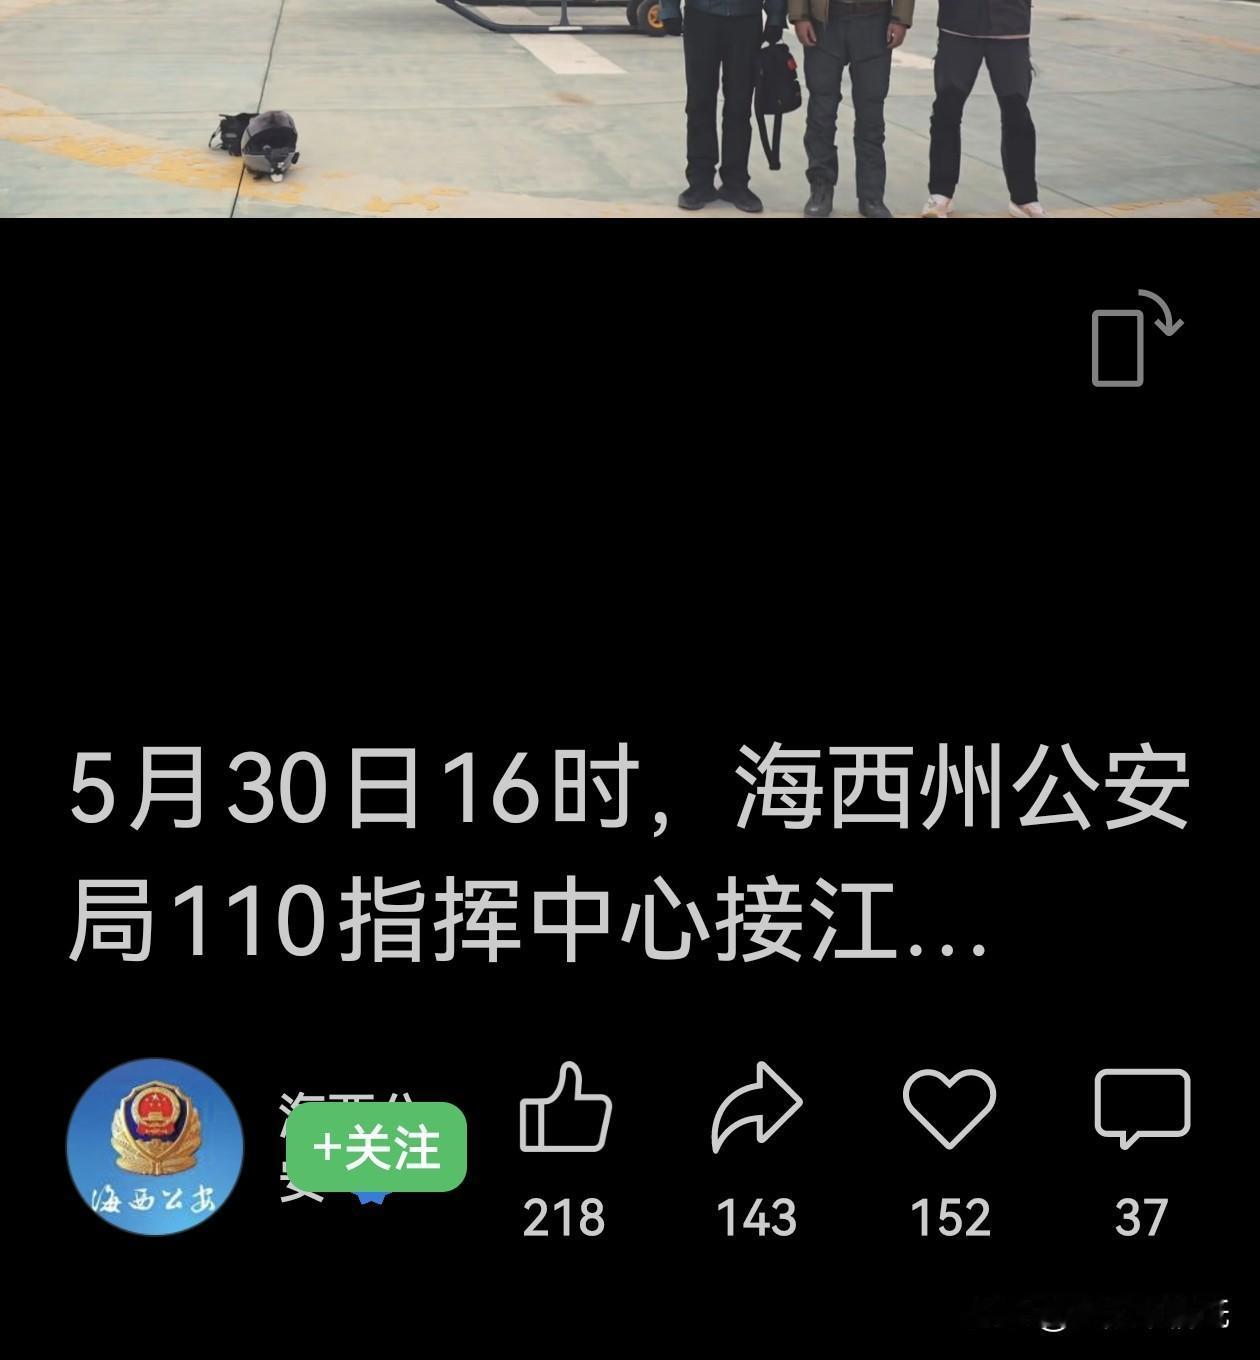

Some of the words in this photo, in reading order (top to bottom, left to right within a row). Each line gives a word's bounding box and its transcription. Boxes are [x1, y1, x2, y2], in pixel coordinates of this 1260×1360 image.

[314, 1124, 441, 1171] +关注
[91, 1184, 216, 1214] 海西公安
[524, 1198, 605, 1237] 218
[718, 1198, 797, 1237] 143
[912, 1198, 991, 1237] 152
[1116, 1198, 1169, 1237] 37
